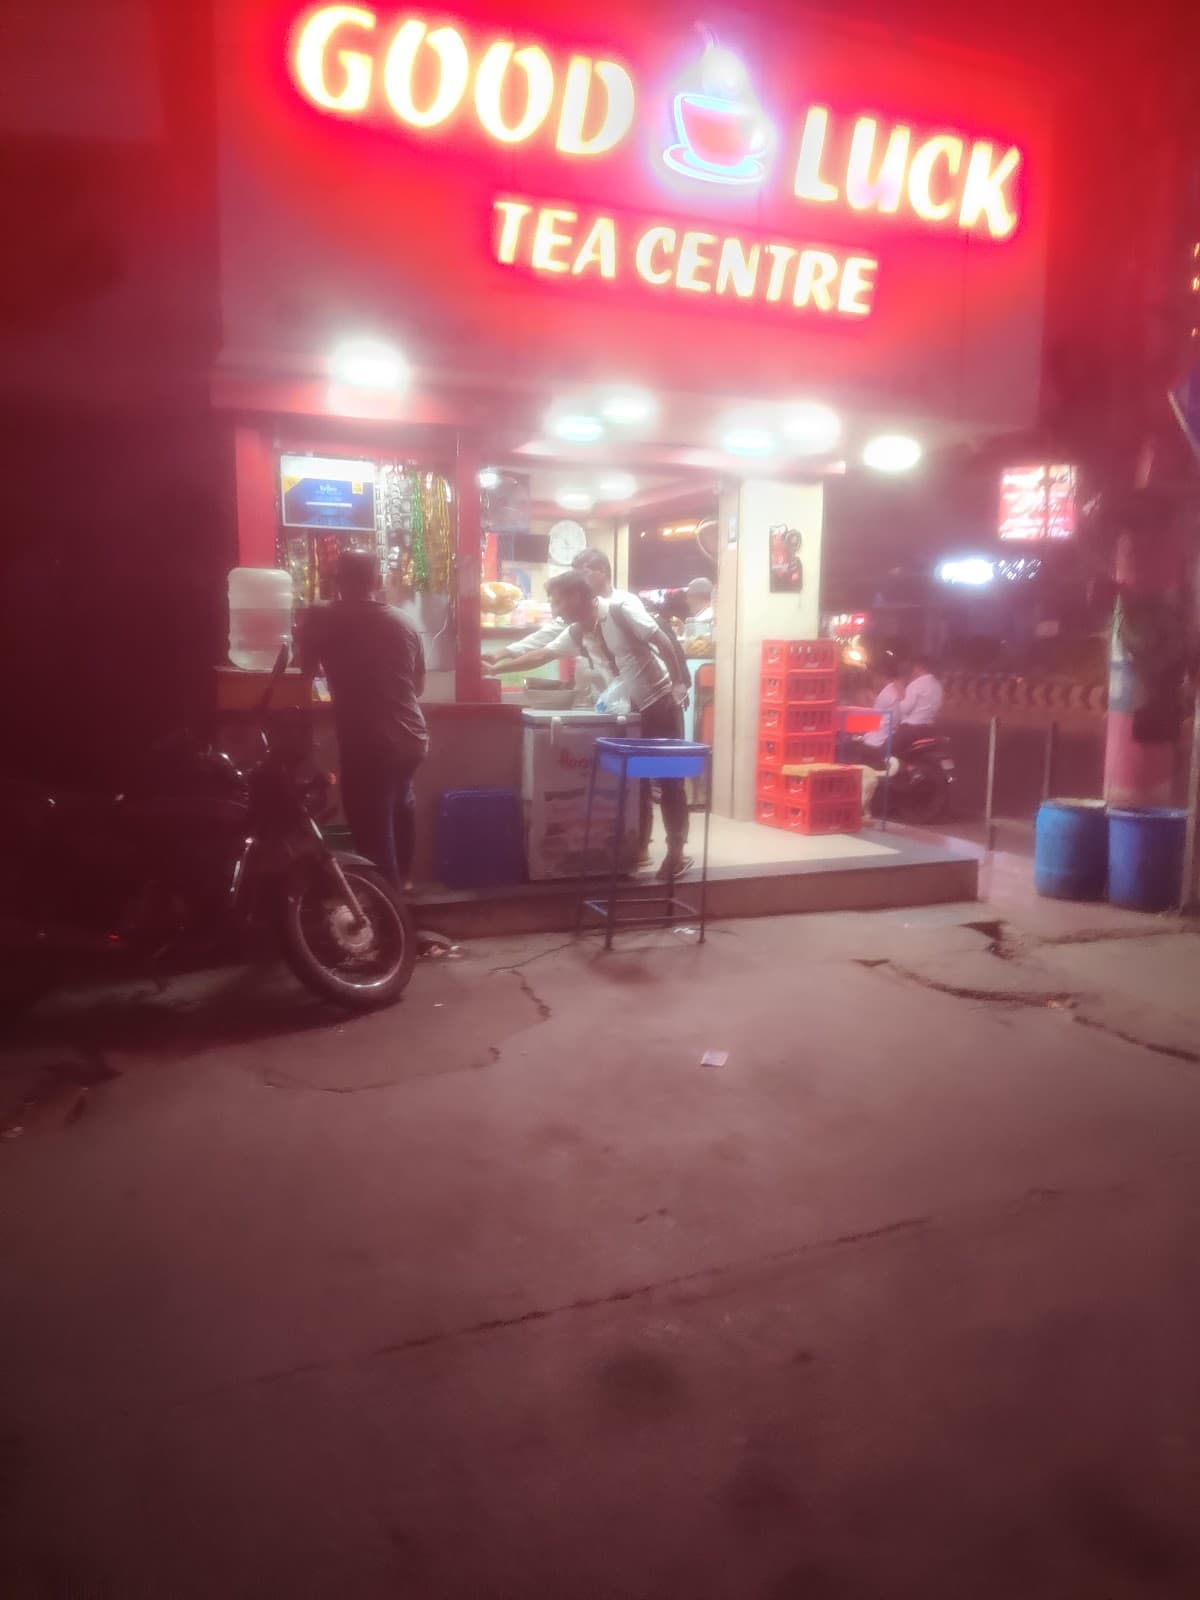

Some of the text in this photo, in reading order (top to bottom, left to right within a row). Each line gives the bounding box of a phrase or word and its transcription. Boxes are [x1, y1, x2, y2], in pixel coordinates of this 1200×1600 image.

[294, 4, 1022, 239] GOOD LUCK
[493, 200, 879, 316] TEA CENTRE
